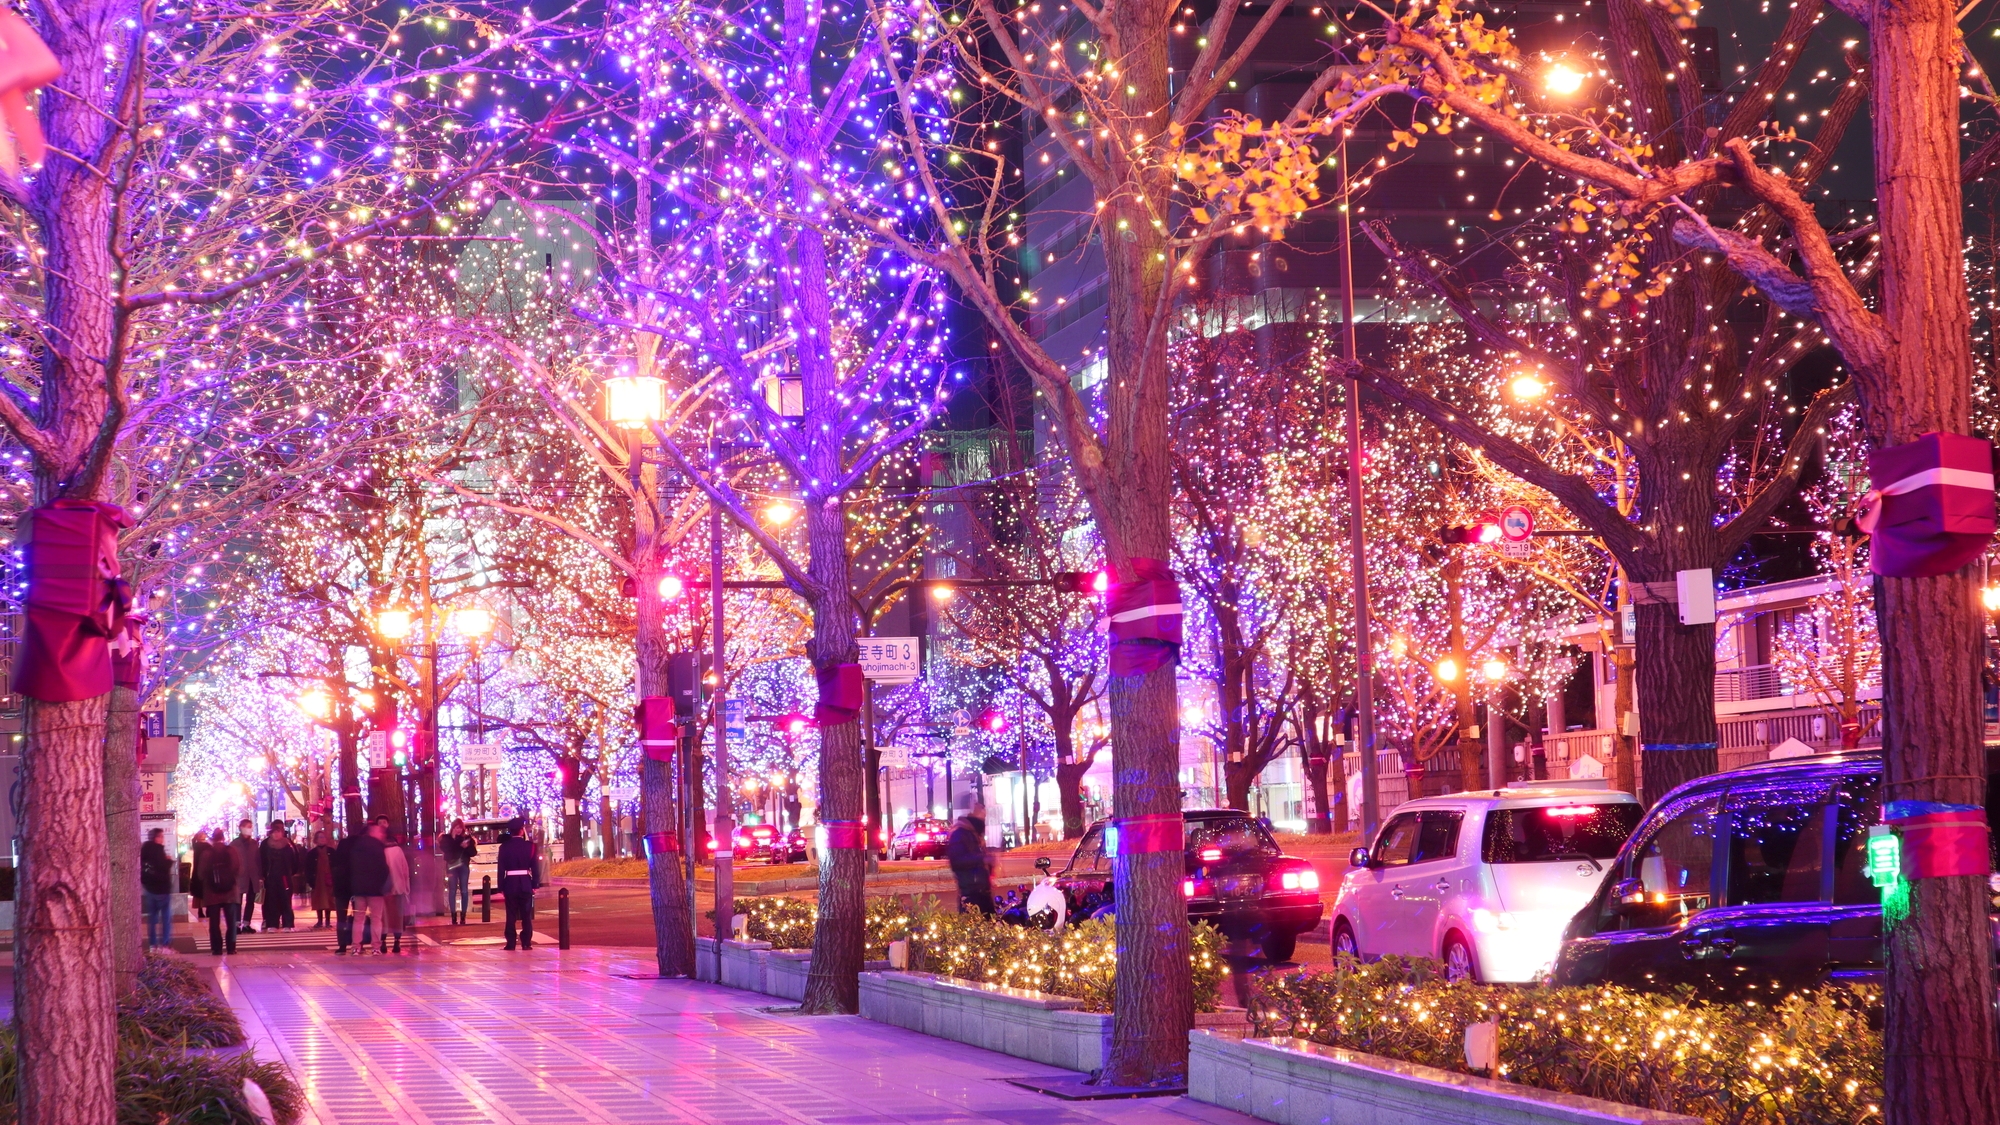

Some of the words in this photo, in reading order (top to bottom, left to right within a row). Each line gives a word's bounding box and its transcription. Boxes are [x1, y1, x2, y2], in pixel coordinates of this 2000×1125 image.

[903, 643, 911, 660] 3
[862, 662, 916, 672] uhojimachi-3
[726, 701, 742, 709] ツ橋
